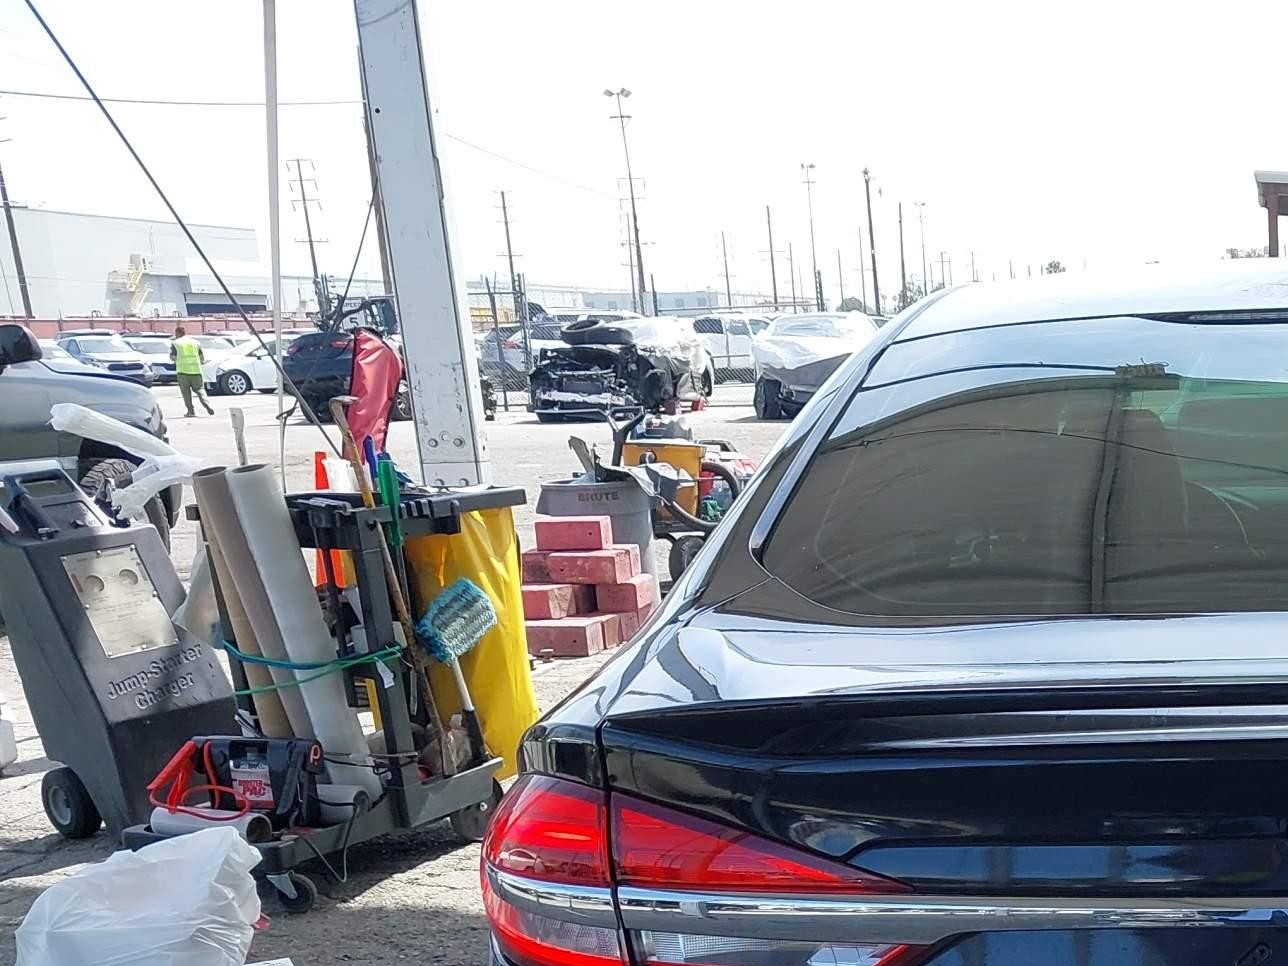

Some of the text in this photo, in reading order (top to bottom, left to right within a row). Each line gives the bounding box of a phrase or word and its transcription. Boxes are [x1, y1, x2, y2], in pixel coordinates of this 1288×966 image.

[577, 491, 619, 502] BRUTE
[108, 644, 202, 699] Jump-Starter
[134, 672, 194, 709] Charger
